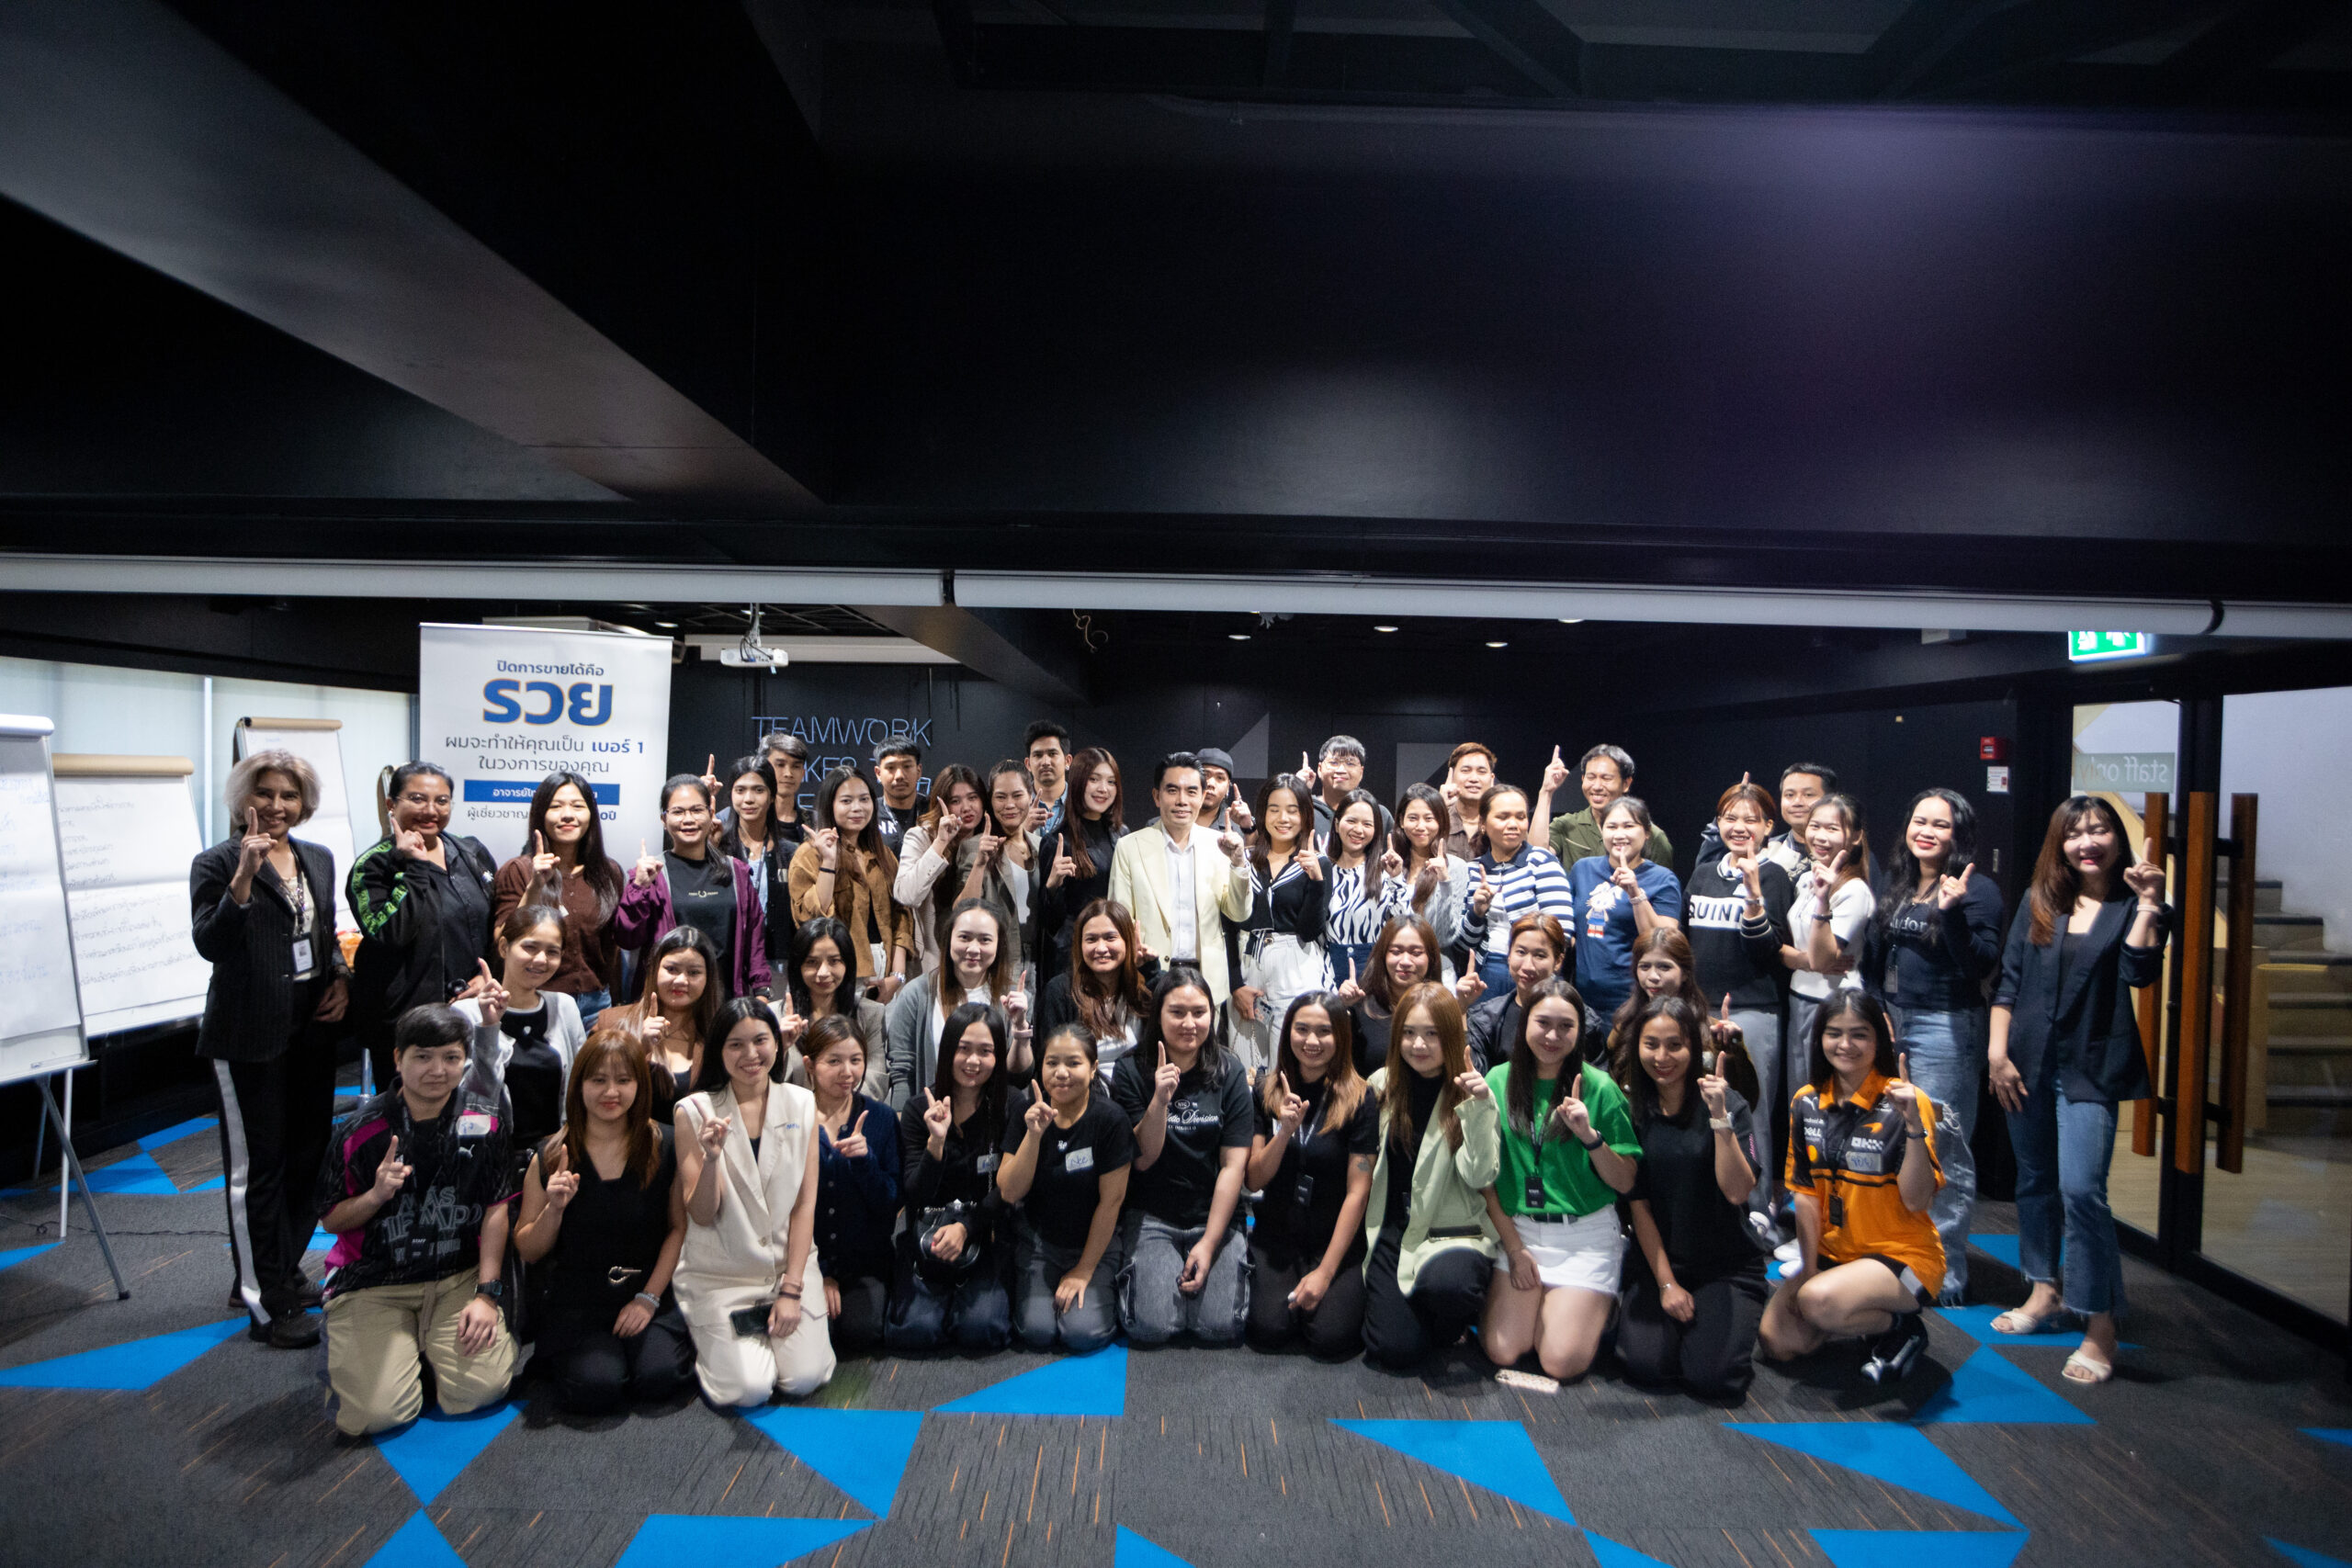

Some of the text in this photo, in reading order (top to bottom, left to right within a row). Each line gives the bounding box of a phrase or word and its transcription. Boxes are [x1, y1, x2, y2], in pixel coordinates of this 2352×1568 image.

[497, 660, 605, 676] ปิดการขายได้คือ
[482, 678, 615, 727] รวย
[752, 716, 933, 747] TEAMWORK
[446, 733, 644, 755] ผมจะทำให้คุณเป็น เบอร์ 1
[479, 755, 609, 776] ในวงการของคุณ
[1182, 1109, 1218, 1124] Division
